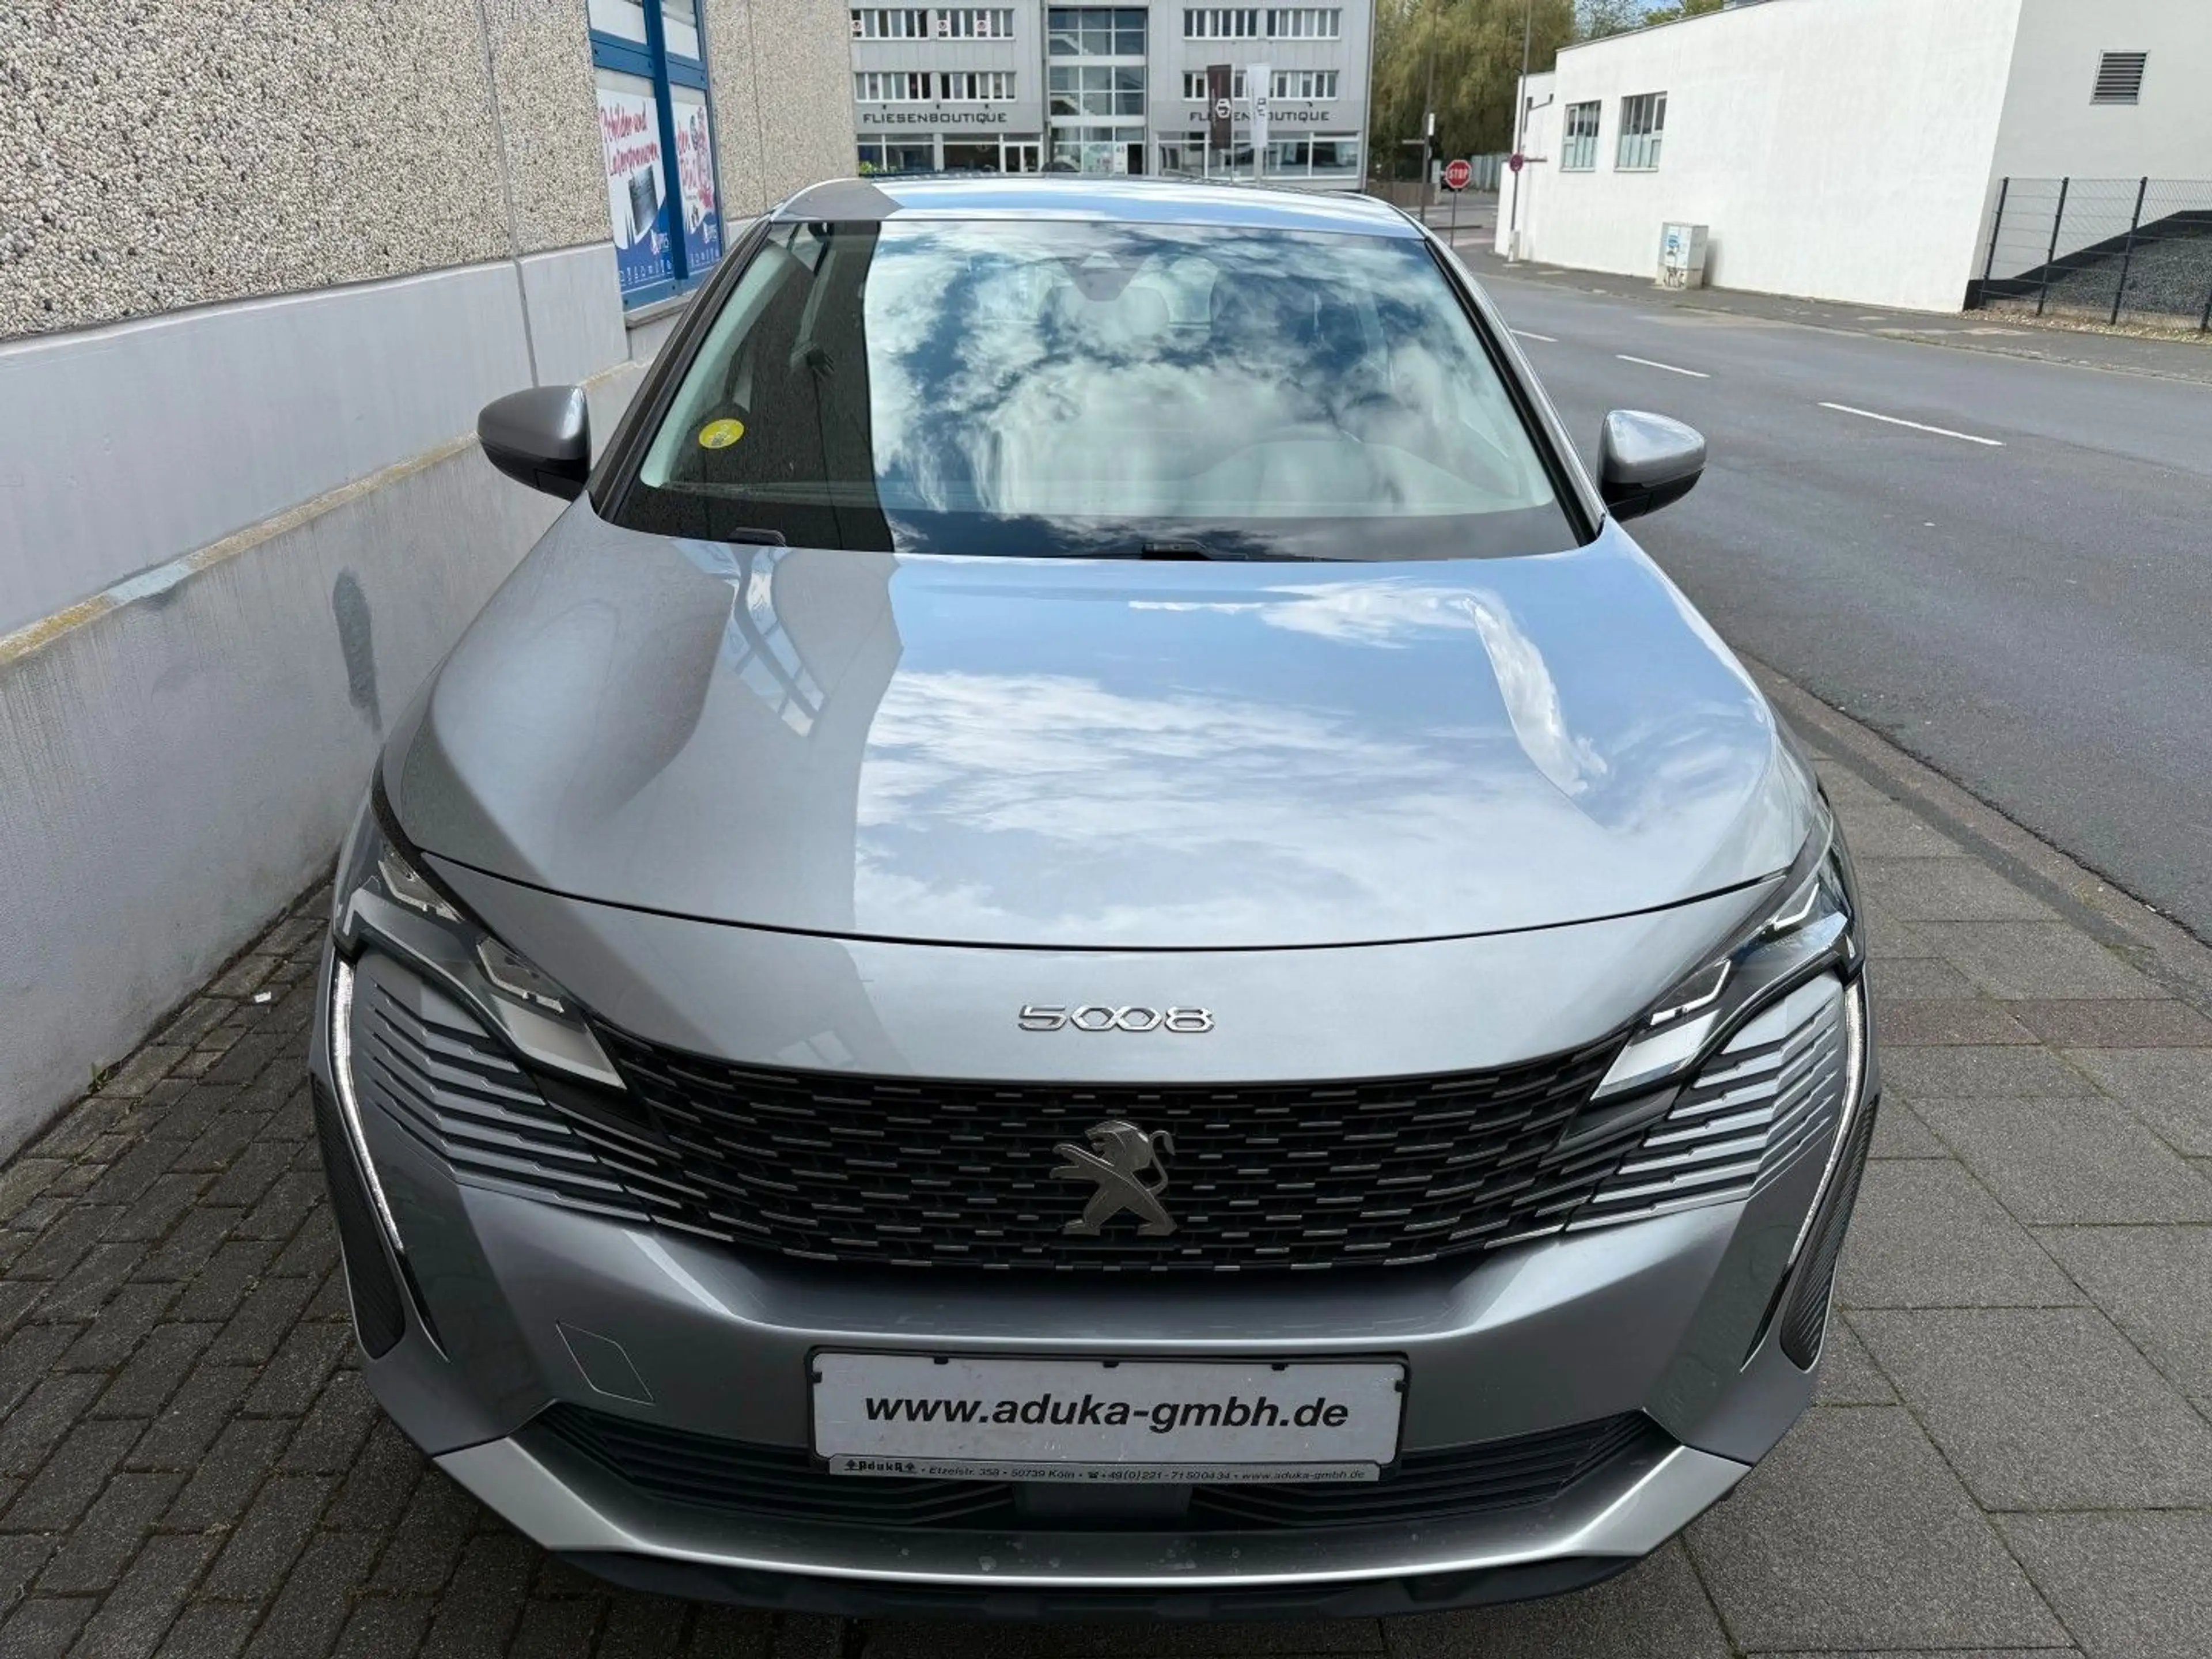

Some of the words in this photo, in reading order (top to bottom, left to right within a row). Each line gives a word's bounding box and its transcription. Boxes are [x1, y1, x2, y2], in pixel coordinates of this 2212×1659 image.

[863, 112, 1007, 123] FLIESENBOUTIQUE
[1449, 168, 1468, 179] STOP
[1018, 1005, 1214, 1033] 5008
[865, 1393, 1349, 1433] www.aduka-gmbh.de
